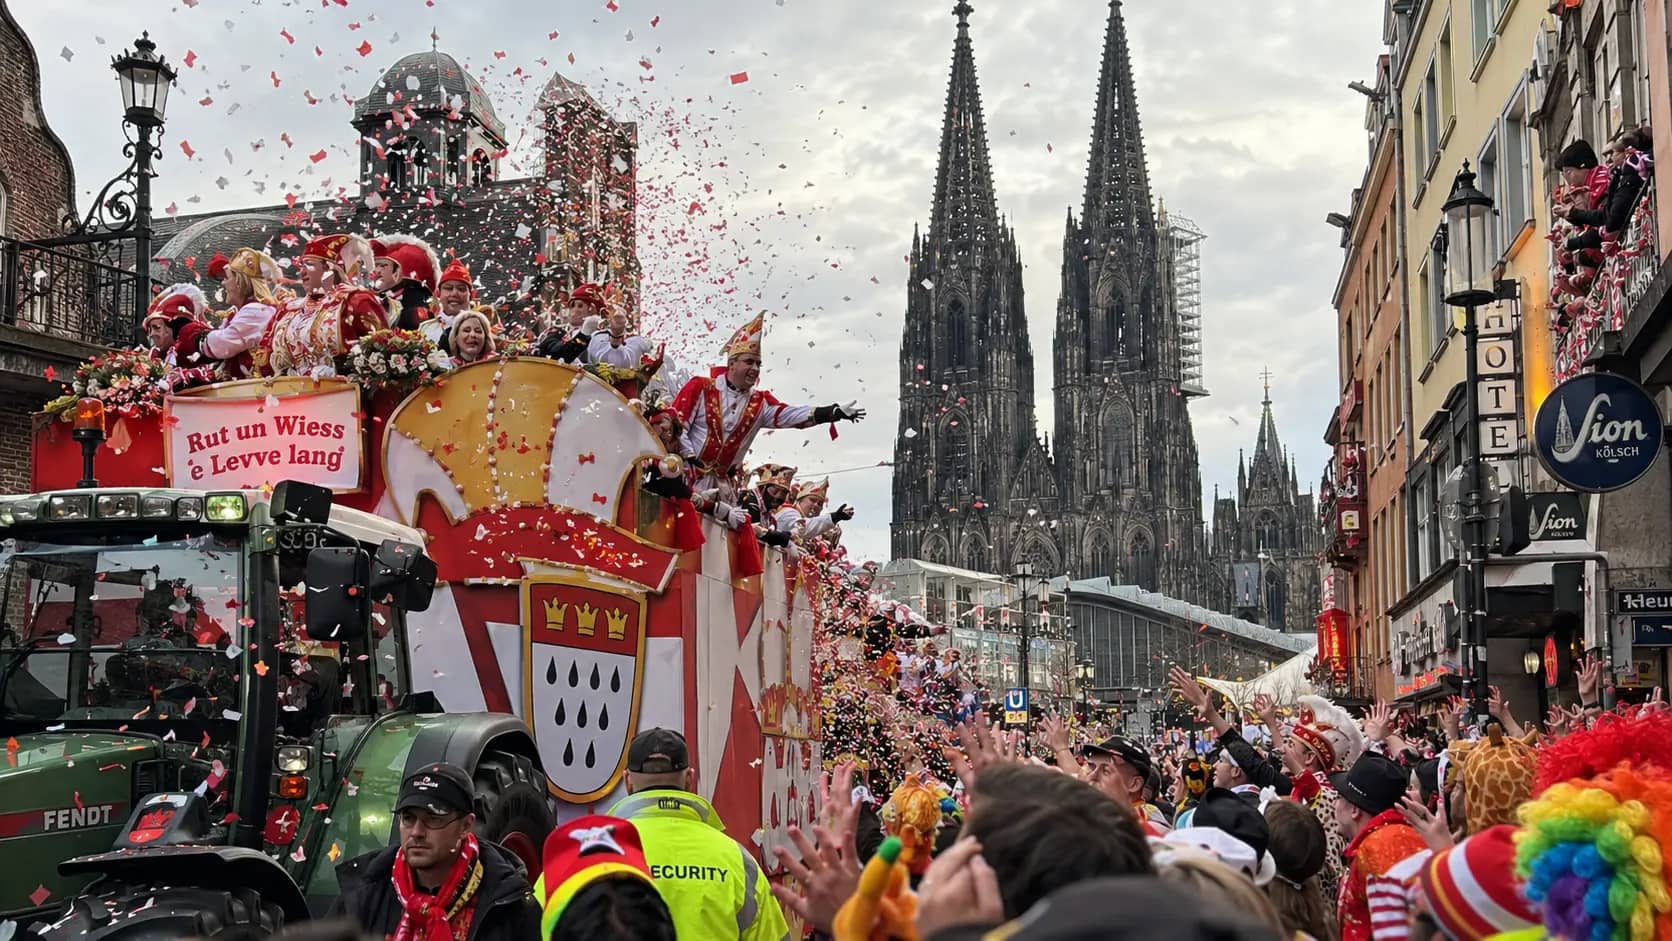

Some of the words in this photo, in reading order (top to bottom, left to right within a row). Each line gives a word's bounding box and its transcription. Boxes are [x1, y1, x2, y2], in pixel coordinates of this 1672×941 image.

[1484, 303, 1511, 488] HOTE
[187, 426, 230, 454] Rut
[236, 422, 266, 441] un
[274, 415, 345, 439] Wiess
[1551, 392, 1648, 463] Sion
[210, 449, 281, 476] Levve
[1596, 445, 1639, 459] KÖLSCH
[1529, 503, 1579, 540] Sion
[1009, 690, 1023, 708] U
[44, 805, 113, 831] FENDT
[651, 865, 728, 882] ECURITY
